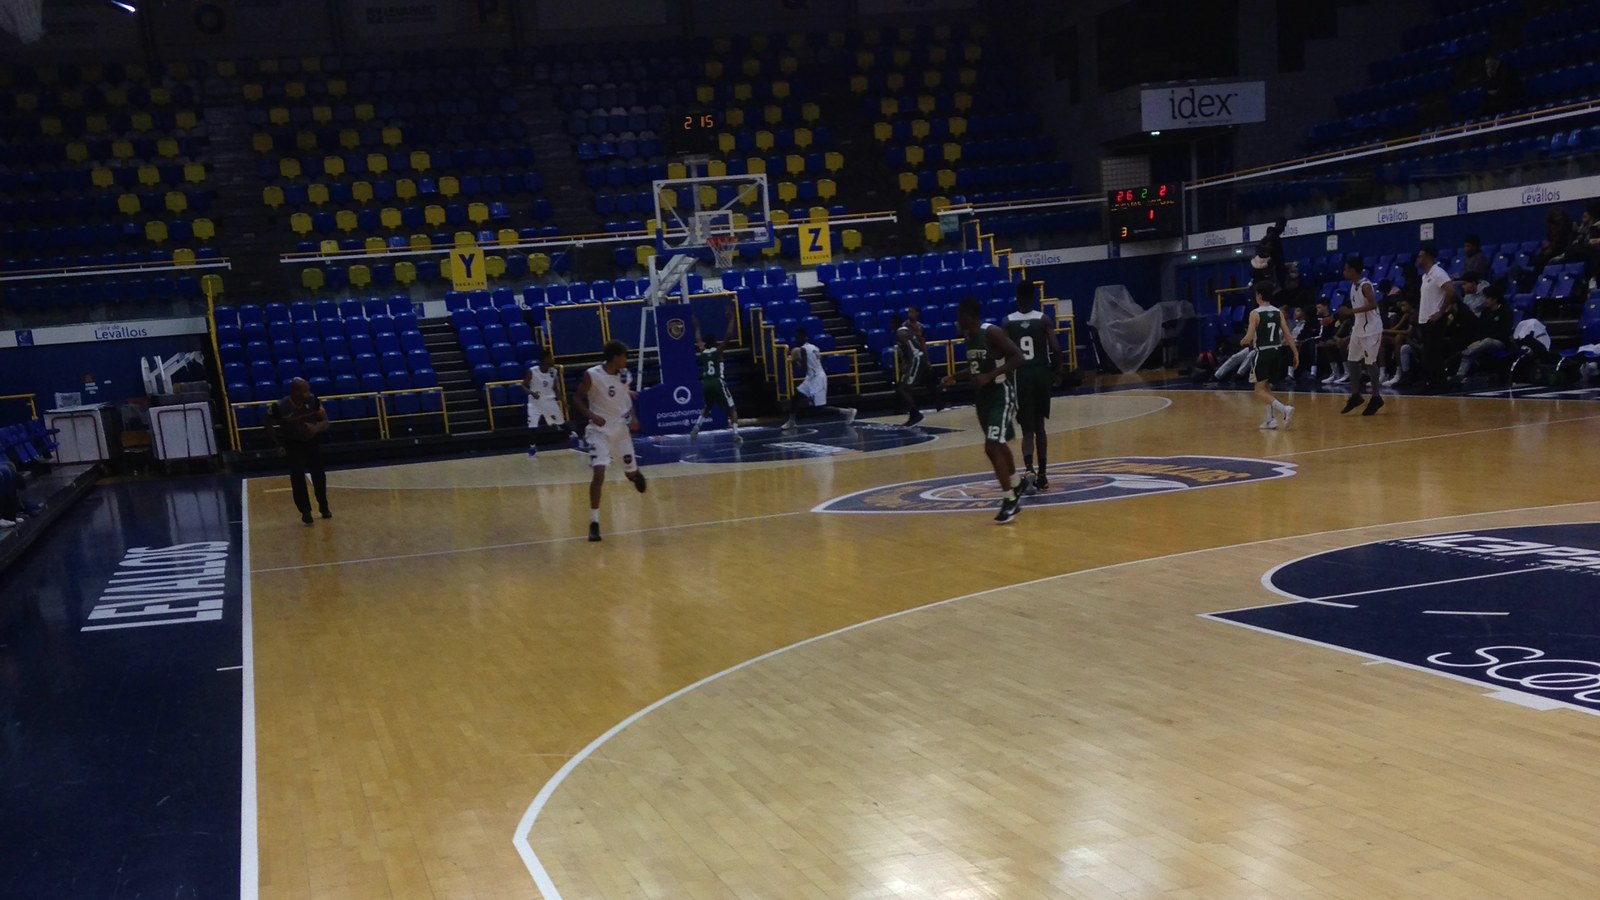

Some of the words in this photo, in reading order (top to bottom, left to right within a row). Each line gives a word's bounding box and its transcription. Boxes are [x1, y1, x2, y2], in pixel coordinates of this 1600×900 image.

[1168, 88, 1232, 119] idex
[684, 116, 693, 130] 2
[700, 114, 714, 128] 15
[1117, 190, 1133, 202] 26
[1141, 188, 1148, 199] 2
[1521, 188, 1560, 204] Levallois
[1377, 209, 1409, 223] Levallois
[808, 227, 823, 251] Z
[1121, 226, 1128, 238] 3
[458, 253, 475, 278] Y
[1020, 253, 1061, 266] Levallois
[94, 326, 147, 340] Levallois
[1267, 322, 1277, 342] 7
[1020, 335, 1034, 360] 9
[707, 360, 716, 376] 6
[608, 386, 616, 398] 6
[987, 425, 1000, 440] 12
[80, 541, 230, 632] LEVALLOIS
